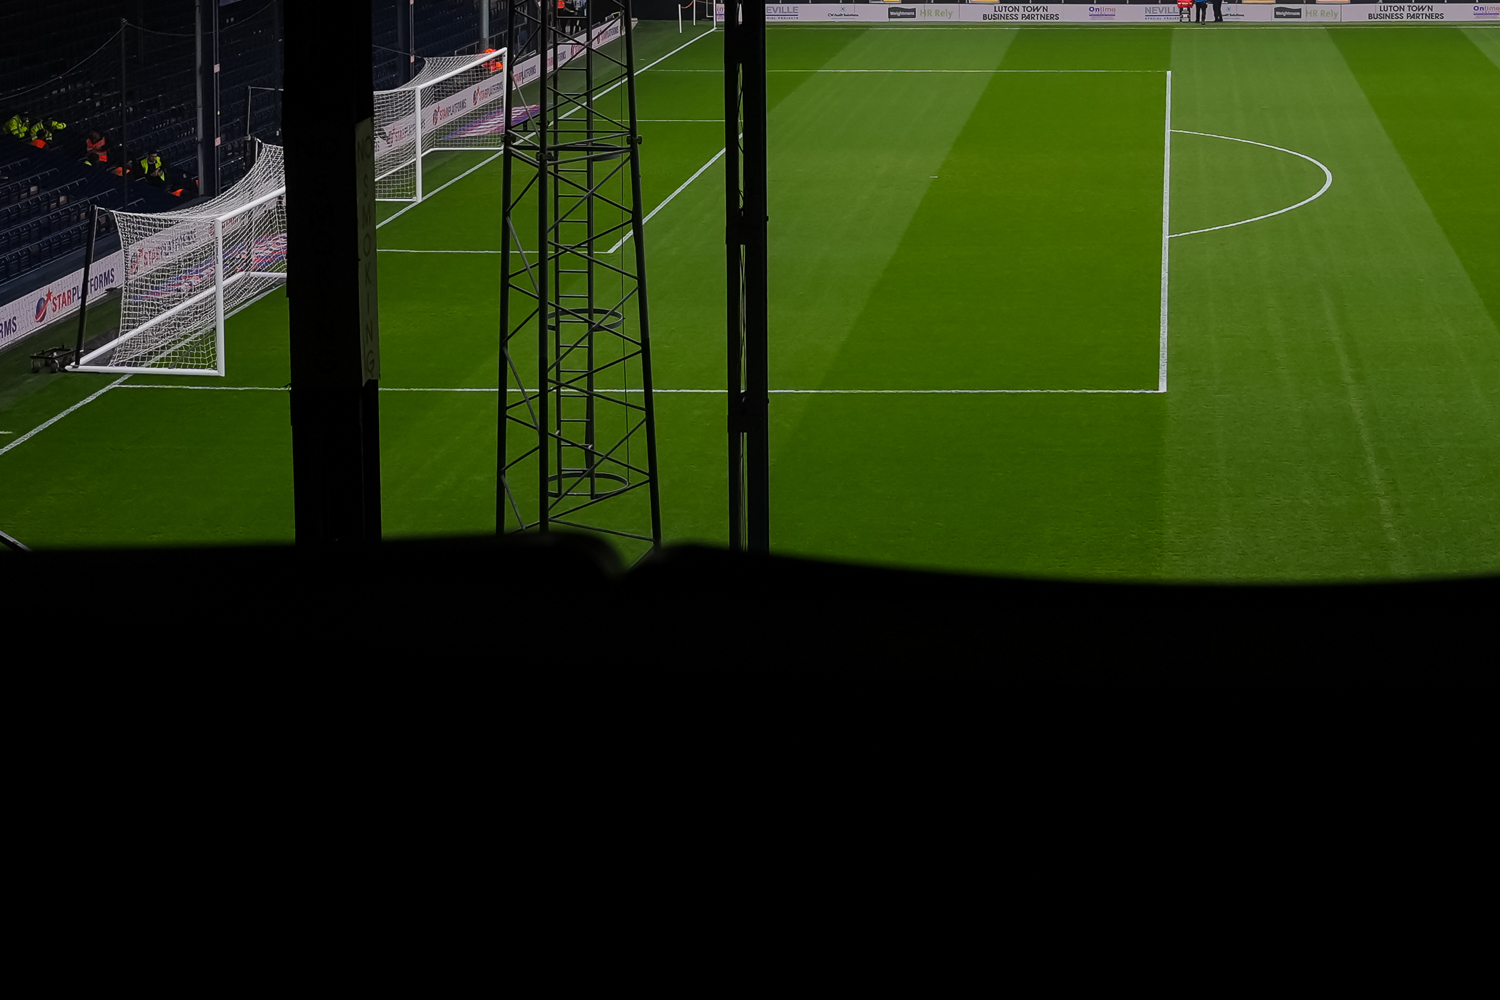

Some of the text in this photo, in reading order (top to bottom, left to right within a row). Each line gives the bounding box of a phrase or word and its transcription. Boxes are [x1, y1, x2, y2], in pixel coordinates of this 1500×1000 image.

[935, 9, 953, 19] Rely
[1321, 9, 1338, 19] Rely
[440, 98, 466, 120] STARPLATFORMS
[357, 134, 372, 160] NO
[362, 174, 375, 374] SMOKING
[52, 268, 115, 312] STARPLFORMS
